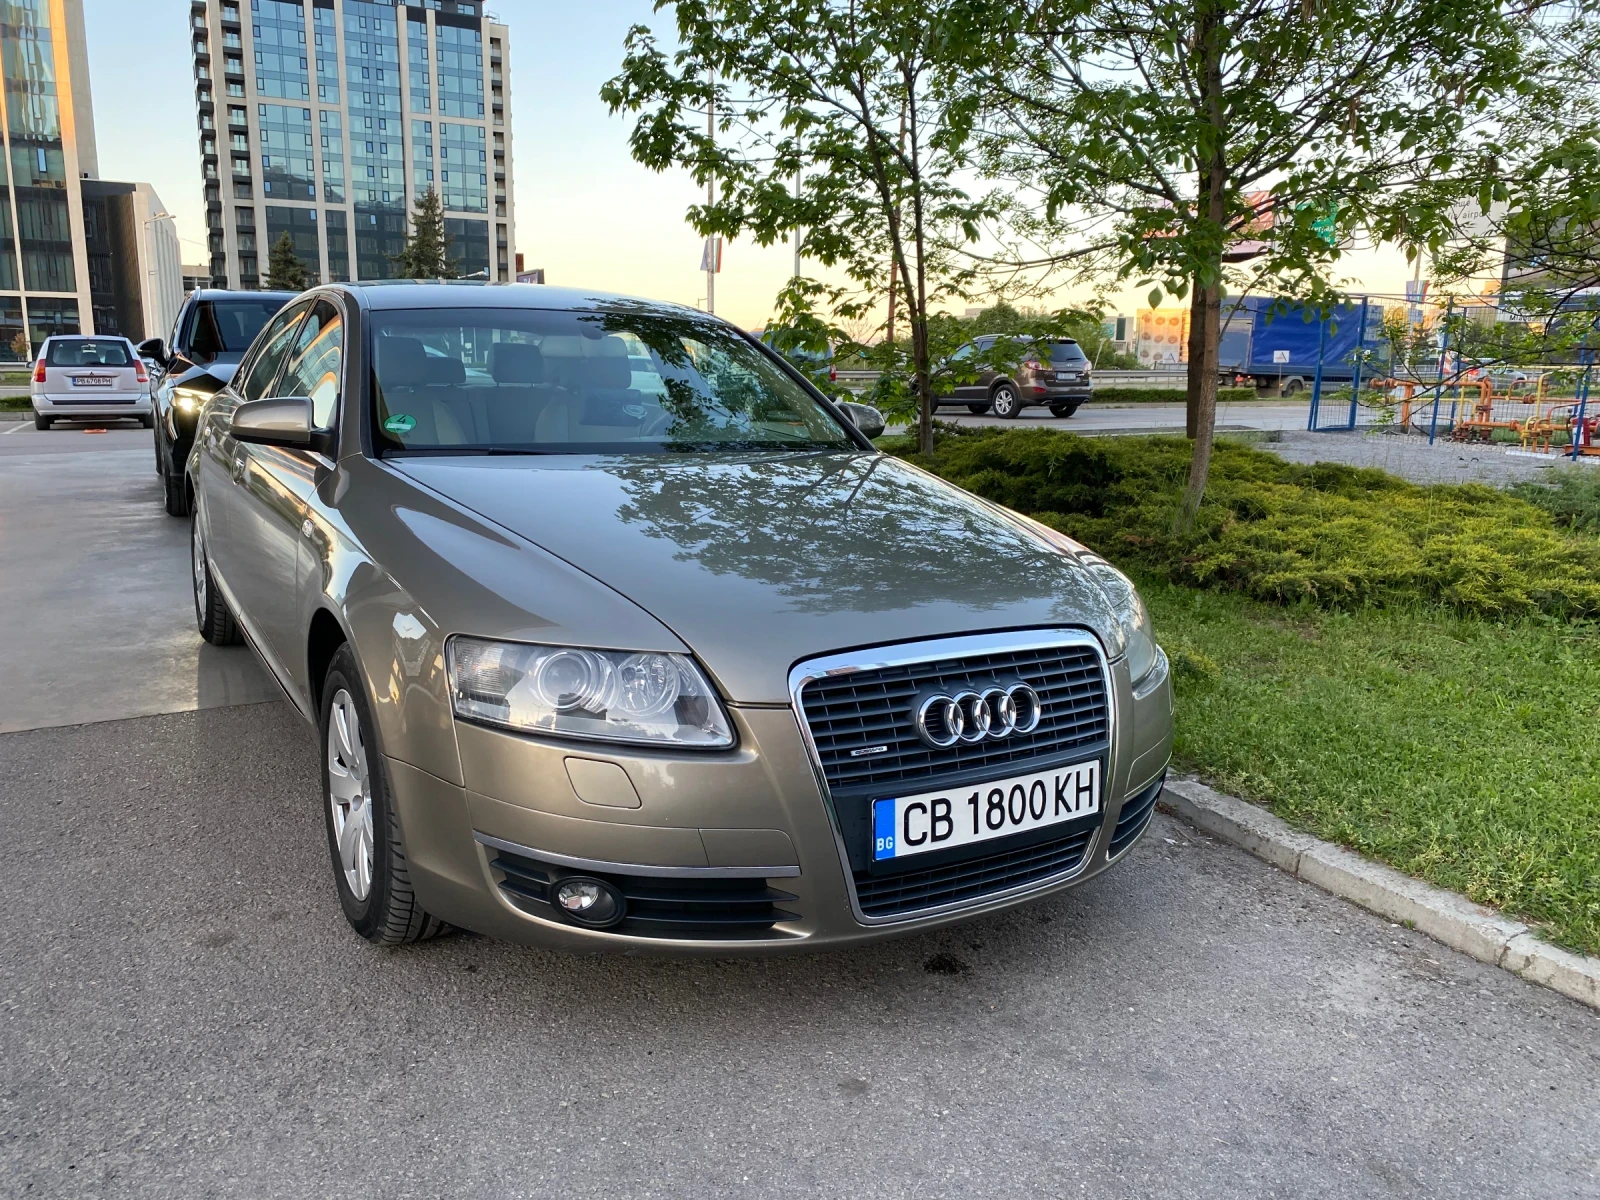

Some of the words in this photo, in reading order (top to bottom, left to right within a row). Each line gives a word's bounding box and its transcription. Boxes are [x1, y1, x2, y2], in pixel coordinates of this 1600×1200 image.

[1462, 210, 1491, 220] airpot
[396, 414, 406, 424] 4
[903, 797, 954, 847] CB
[967, 779, 1047, 835] 1800
[1054, 767, 1094, 816] KH
[876, 836, 894, 852] BG
